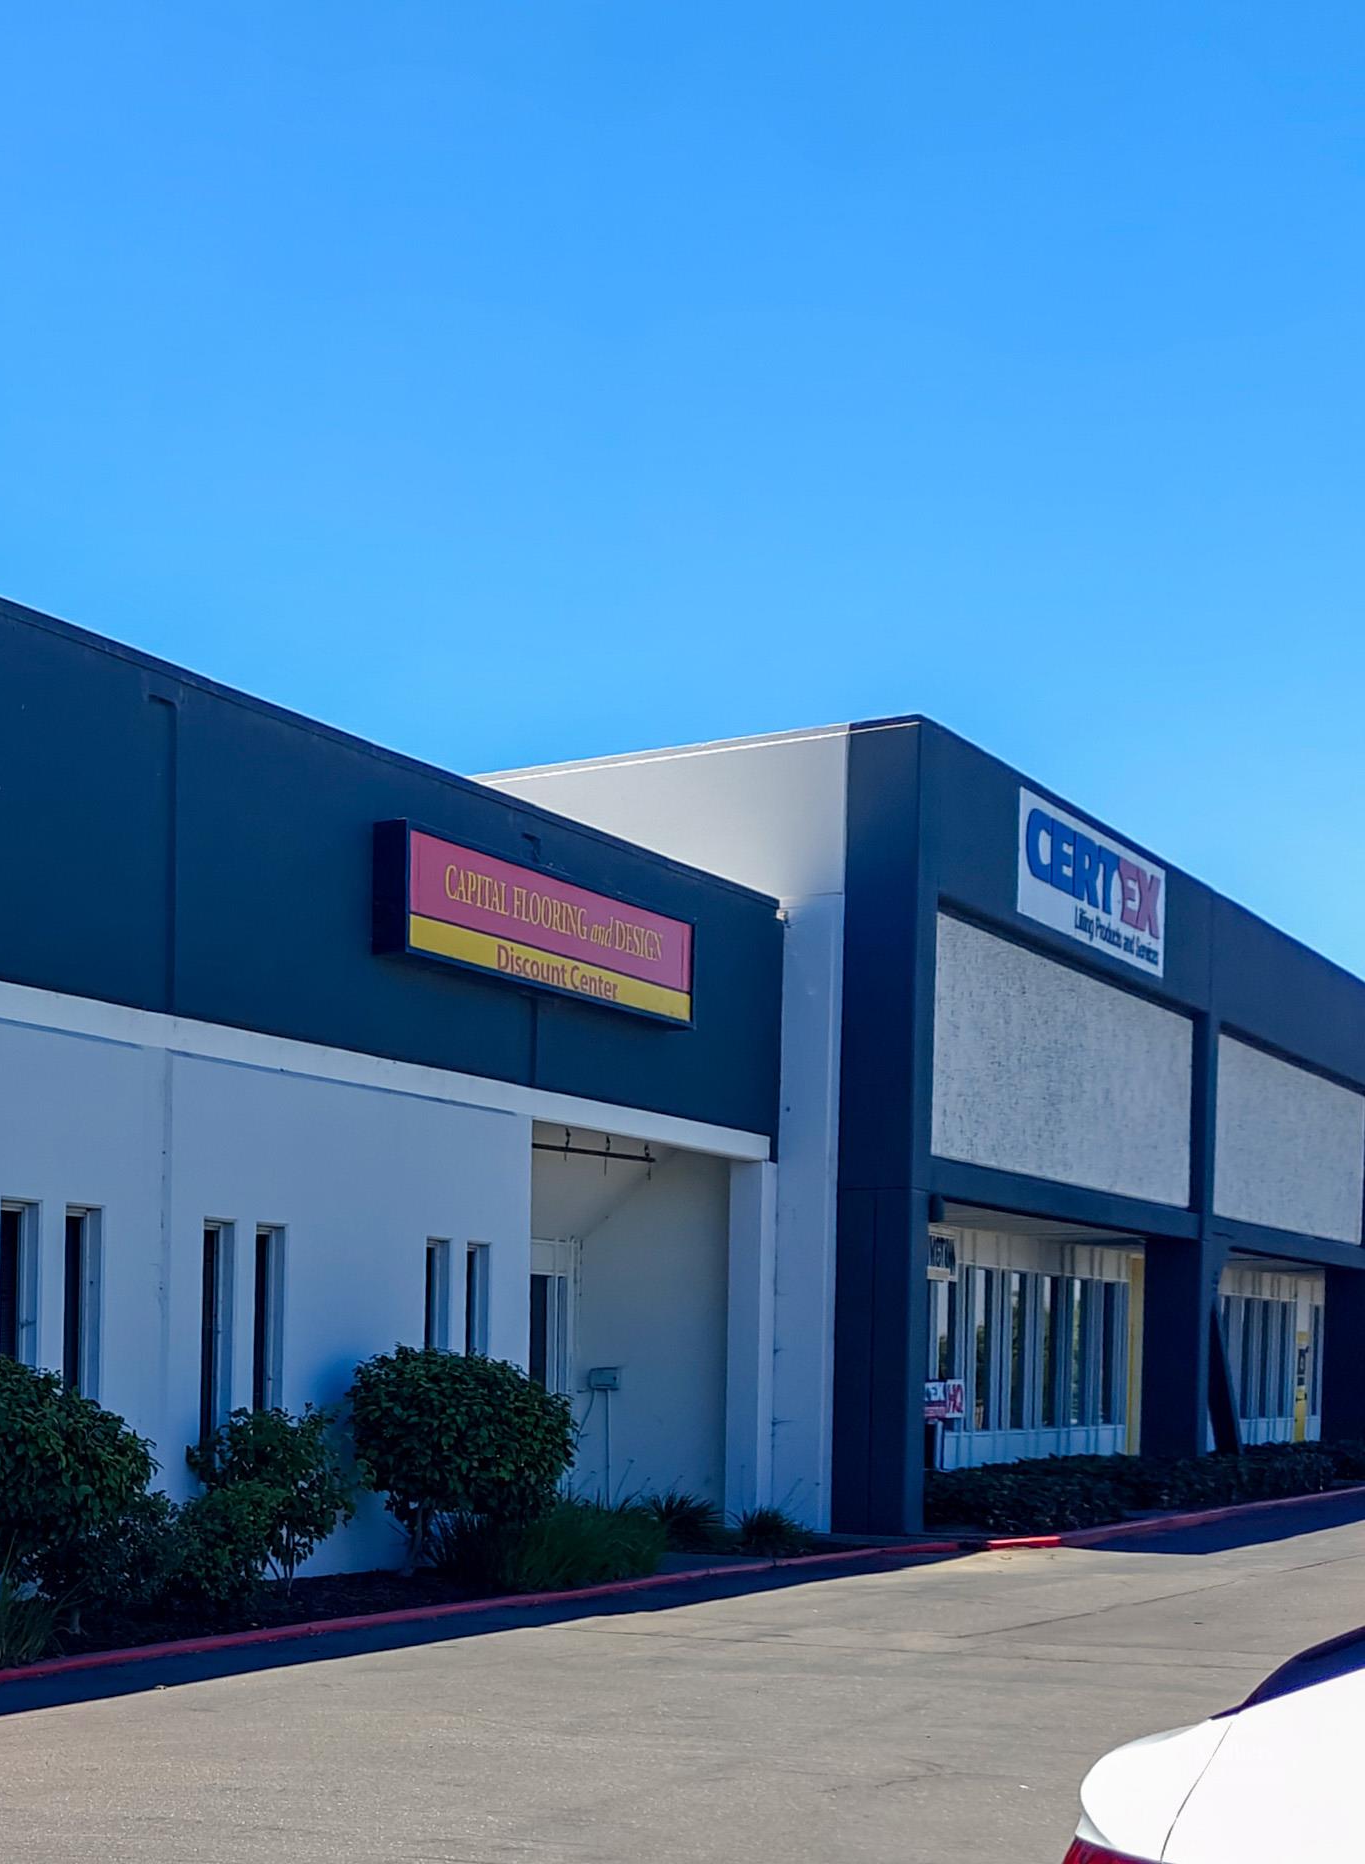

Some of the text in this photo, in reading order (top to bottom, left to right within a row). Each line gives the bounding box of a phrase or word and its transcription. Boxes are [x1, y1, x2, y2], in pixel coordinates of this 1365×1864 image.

[444, 864, 664, 962] CAPITAL FLOORING and DESIGN
[1025, 808, 1162, 940] CERTEX
[1074, 905, 1094, 942] Lifting
[496, 943, 620, 1001] Discount Center
